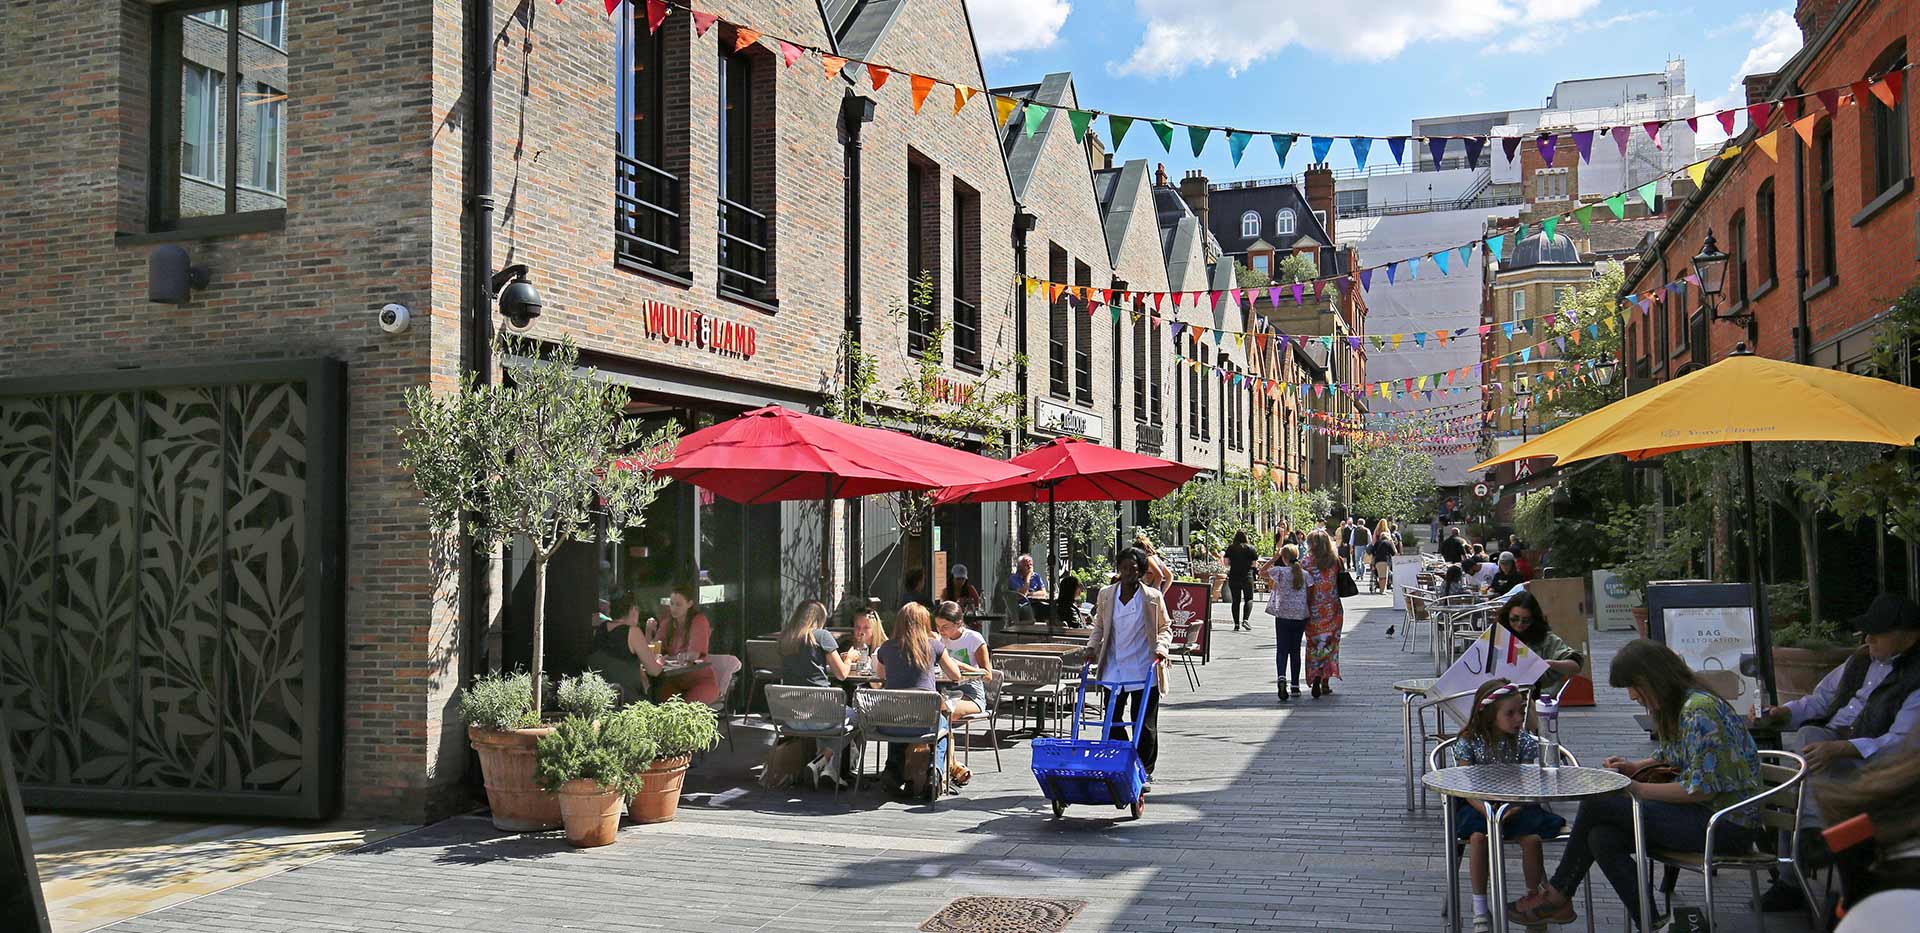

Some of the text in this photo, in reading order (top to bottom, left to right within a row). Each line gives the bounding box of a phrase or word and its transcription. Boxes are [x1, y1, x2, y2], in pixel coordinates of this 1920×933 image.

[644, 299, 701, 344] WULF
[711, 316, 757, 356] LAMB
[1697, 629, 1721, 637] BAG
